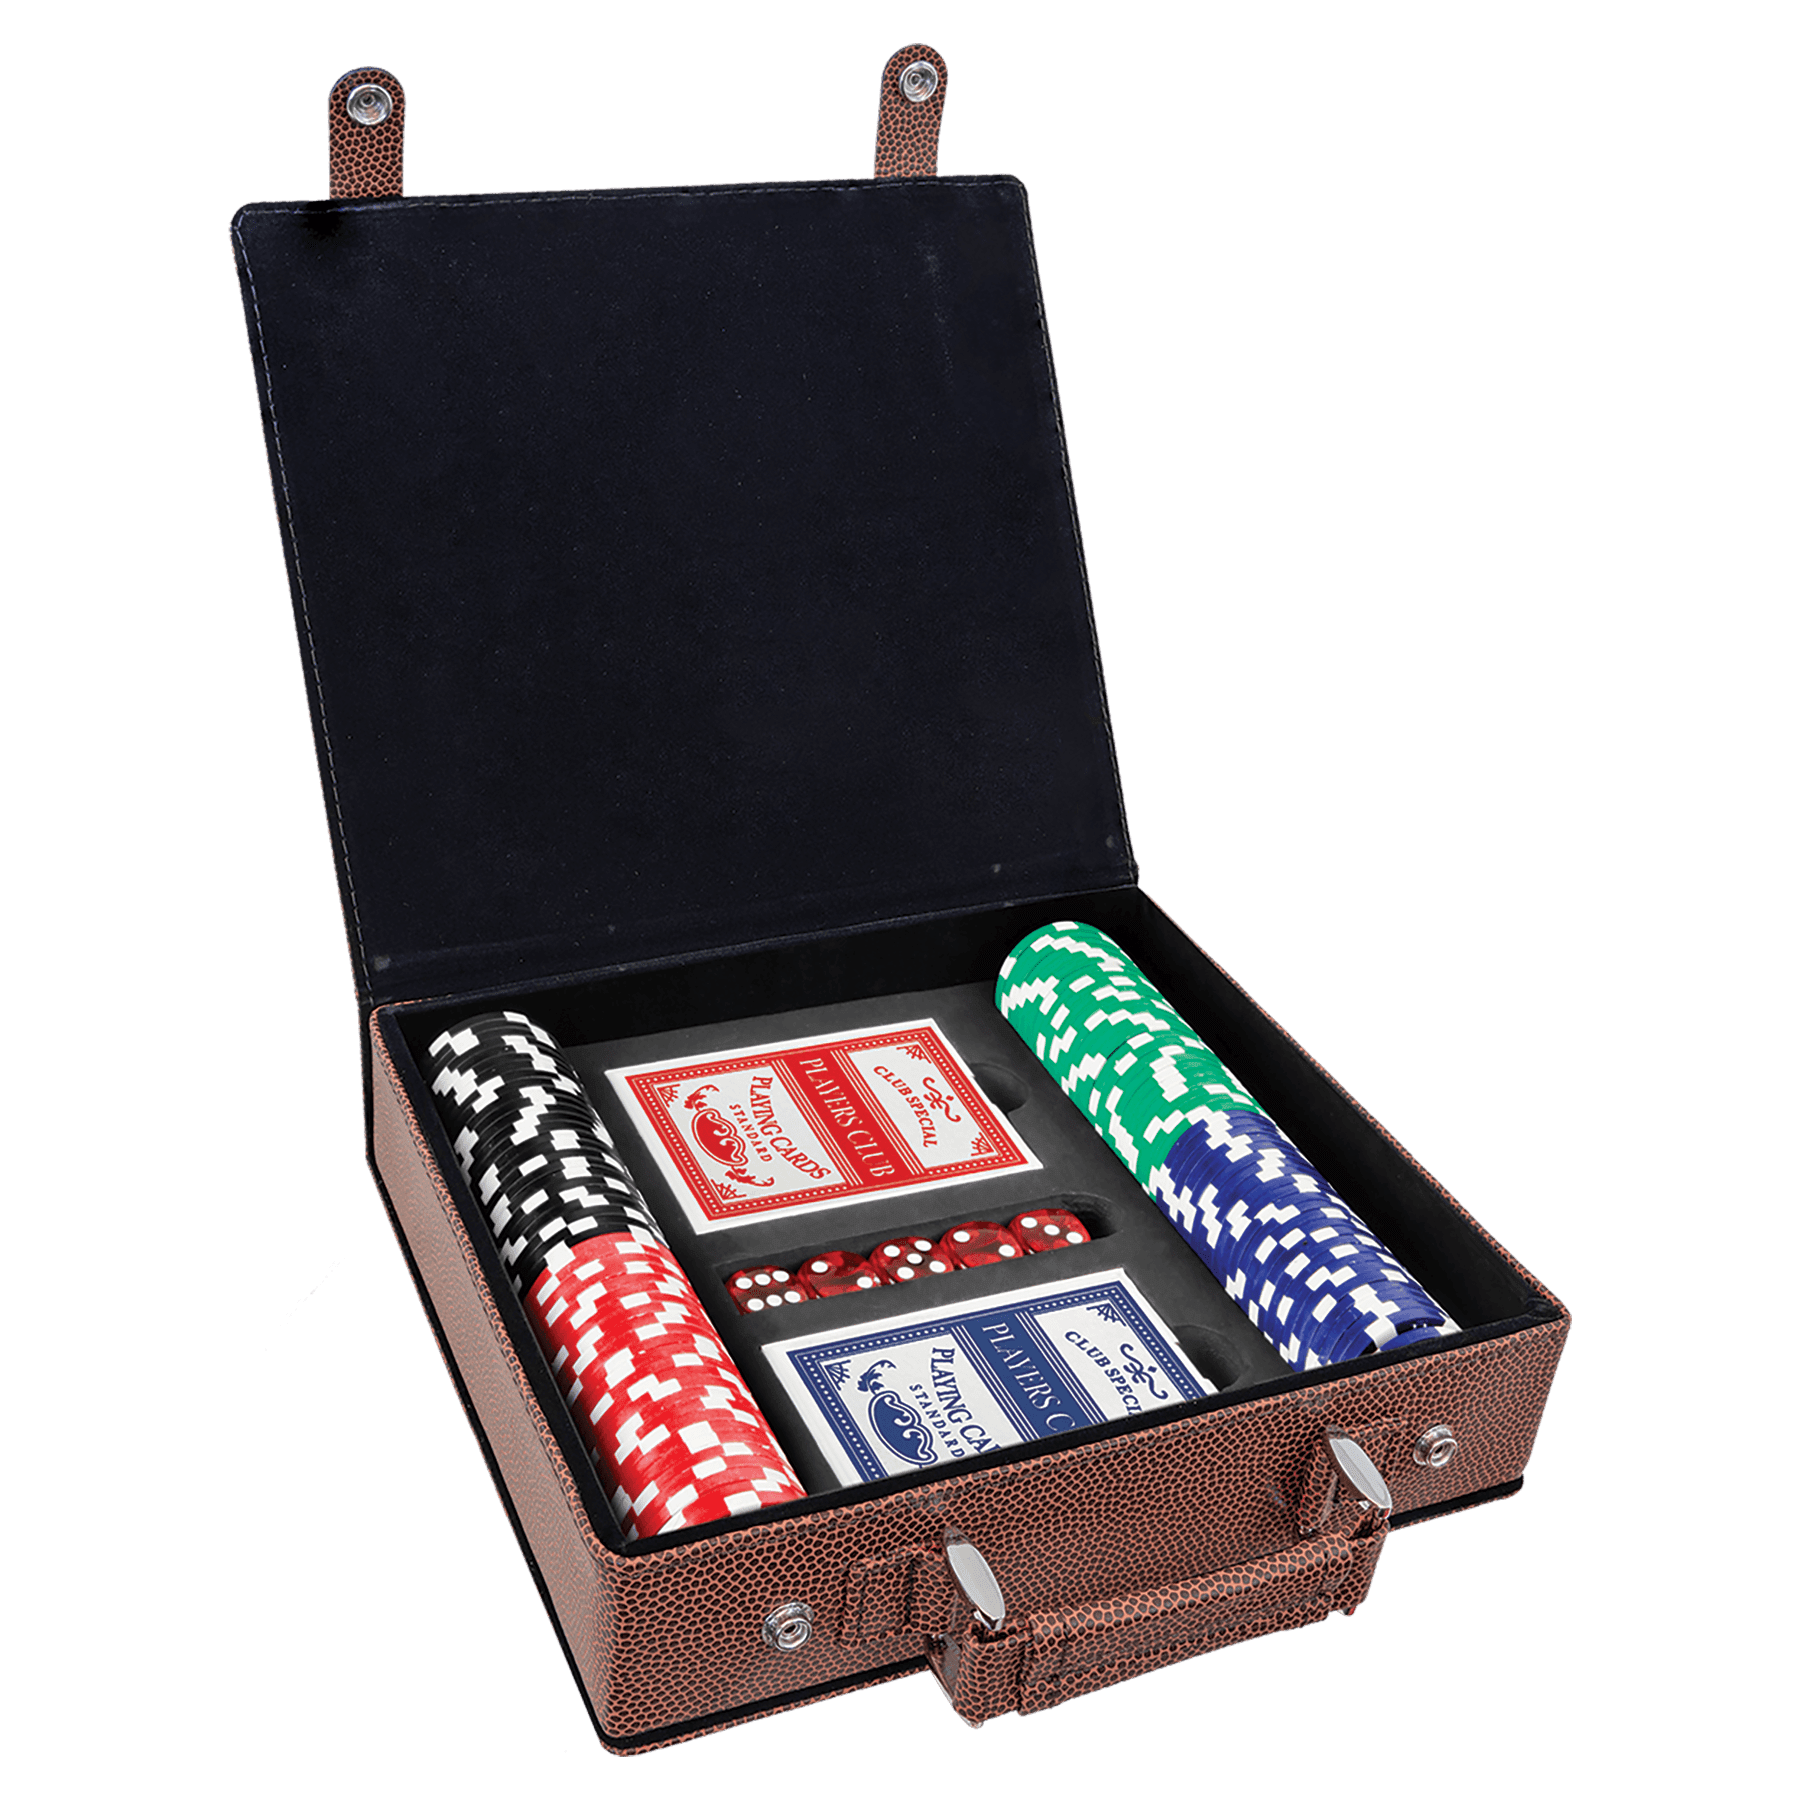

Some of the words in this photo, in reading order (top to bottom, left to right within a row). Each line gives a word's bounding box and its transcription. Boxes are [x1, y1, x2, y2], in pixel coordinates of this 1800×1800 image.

[729, 1104, 772, 1161] STANDARD
[750, 1076, 783, 1136] PLAYING
[769, 1136, 831, 1179] CARDS
[800, 1058, 864, 1127] PLAYERS
[847, 1130, 895, 1177] CLUB
[873, 1065, 912, 1095] CLUB
[905, 1096, 938, 1148] SPECIAL
[931, 1347, 973, 1423] PLAYING
[981, 1323, 1060, 1409] PLAYERS
[1065, 1331, 1111, 1367] CLUB
[1104, 1368, 1142, 1415] SPECI
[909, 1384, 965, 1457] STANDARD
